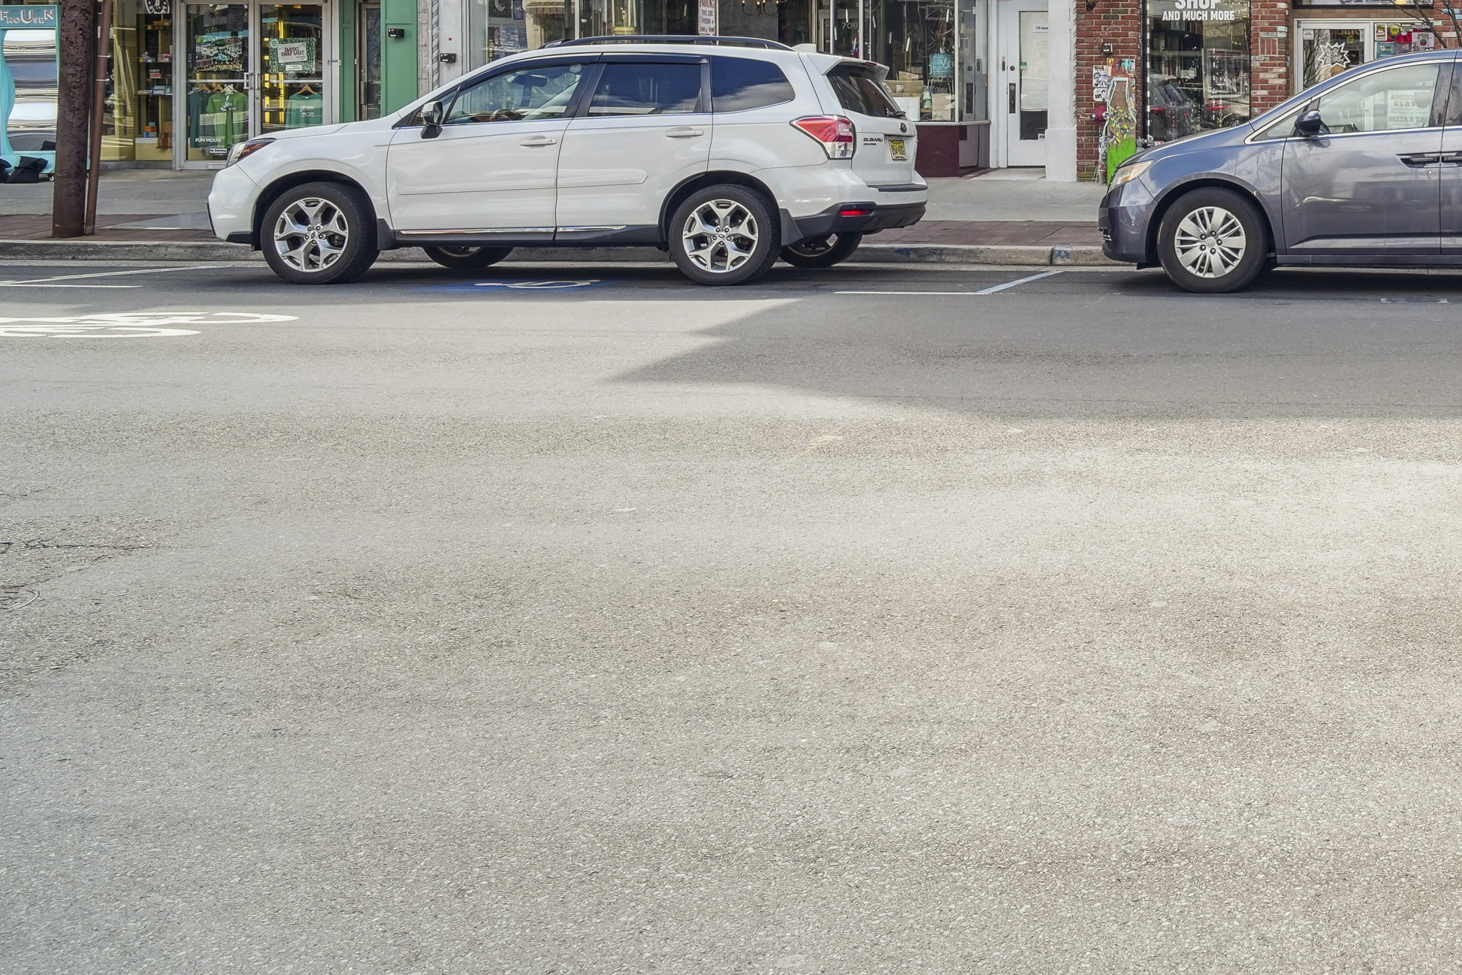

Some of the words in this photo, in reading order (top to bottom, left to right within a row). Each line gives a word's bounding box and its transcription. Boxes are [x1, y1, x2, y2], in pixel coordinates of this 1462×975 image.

[1162, 10, 1180, 21] AND
[1182, 10, 1208, 21] MUCH
[1210, 10, 1235, 21] MORE
